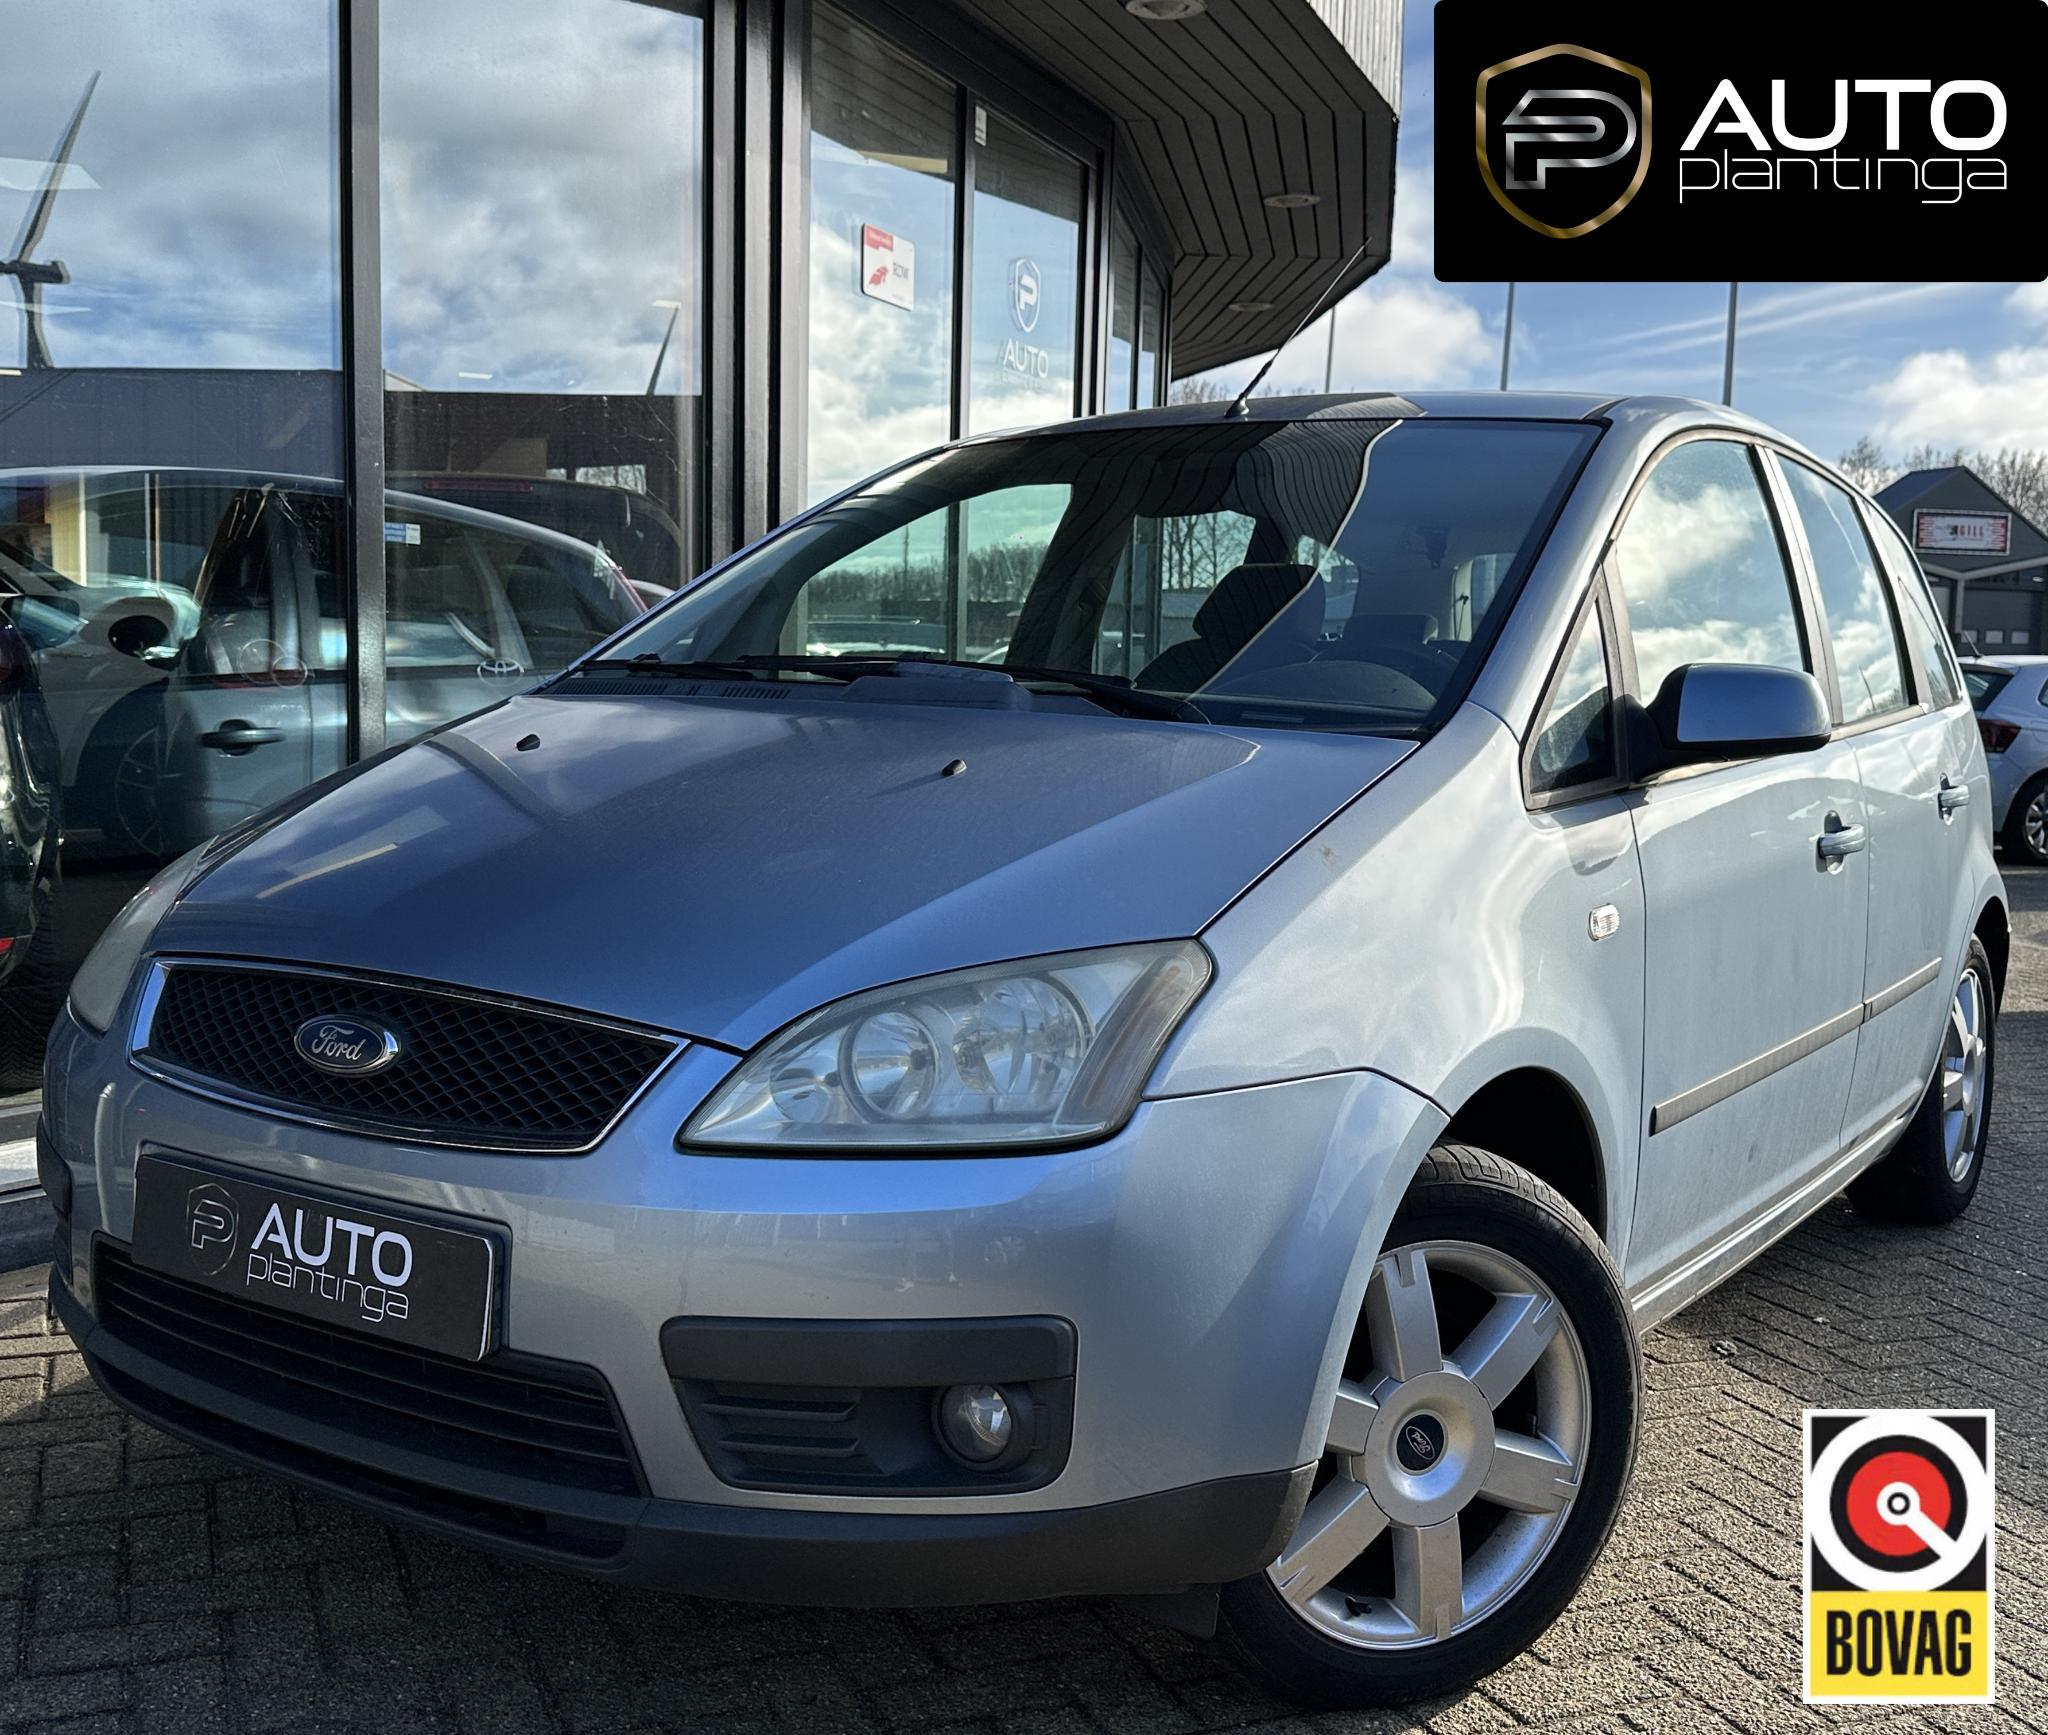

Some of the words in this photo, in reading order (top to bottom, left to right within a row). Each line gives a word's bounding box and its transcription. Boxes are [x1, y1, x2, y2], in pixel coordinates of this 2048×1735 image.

[1003, 338, 1049, 379] AUTO
[311, 1024, 366, 1061] Ford
[250, 1202, 413, 1287] AUTO
[246, 1252, 410, 1323] plantinga
[1411, 1431, 1431, 1454] Ford
